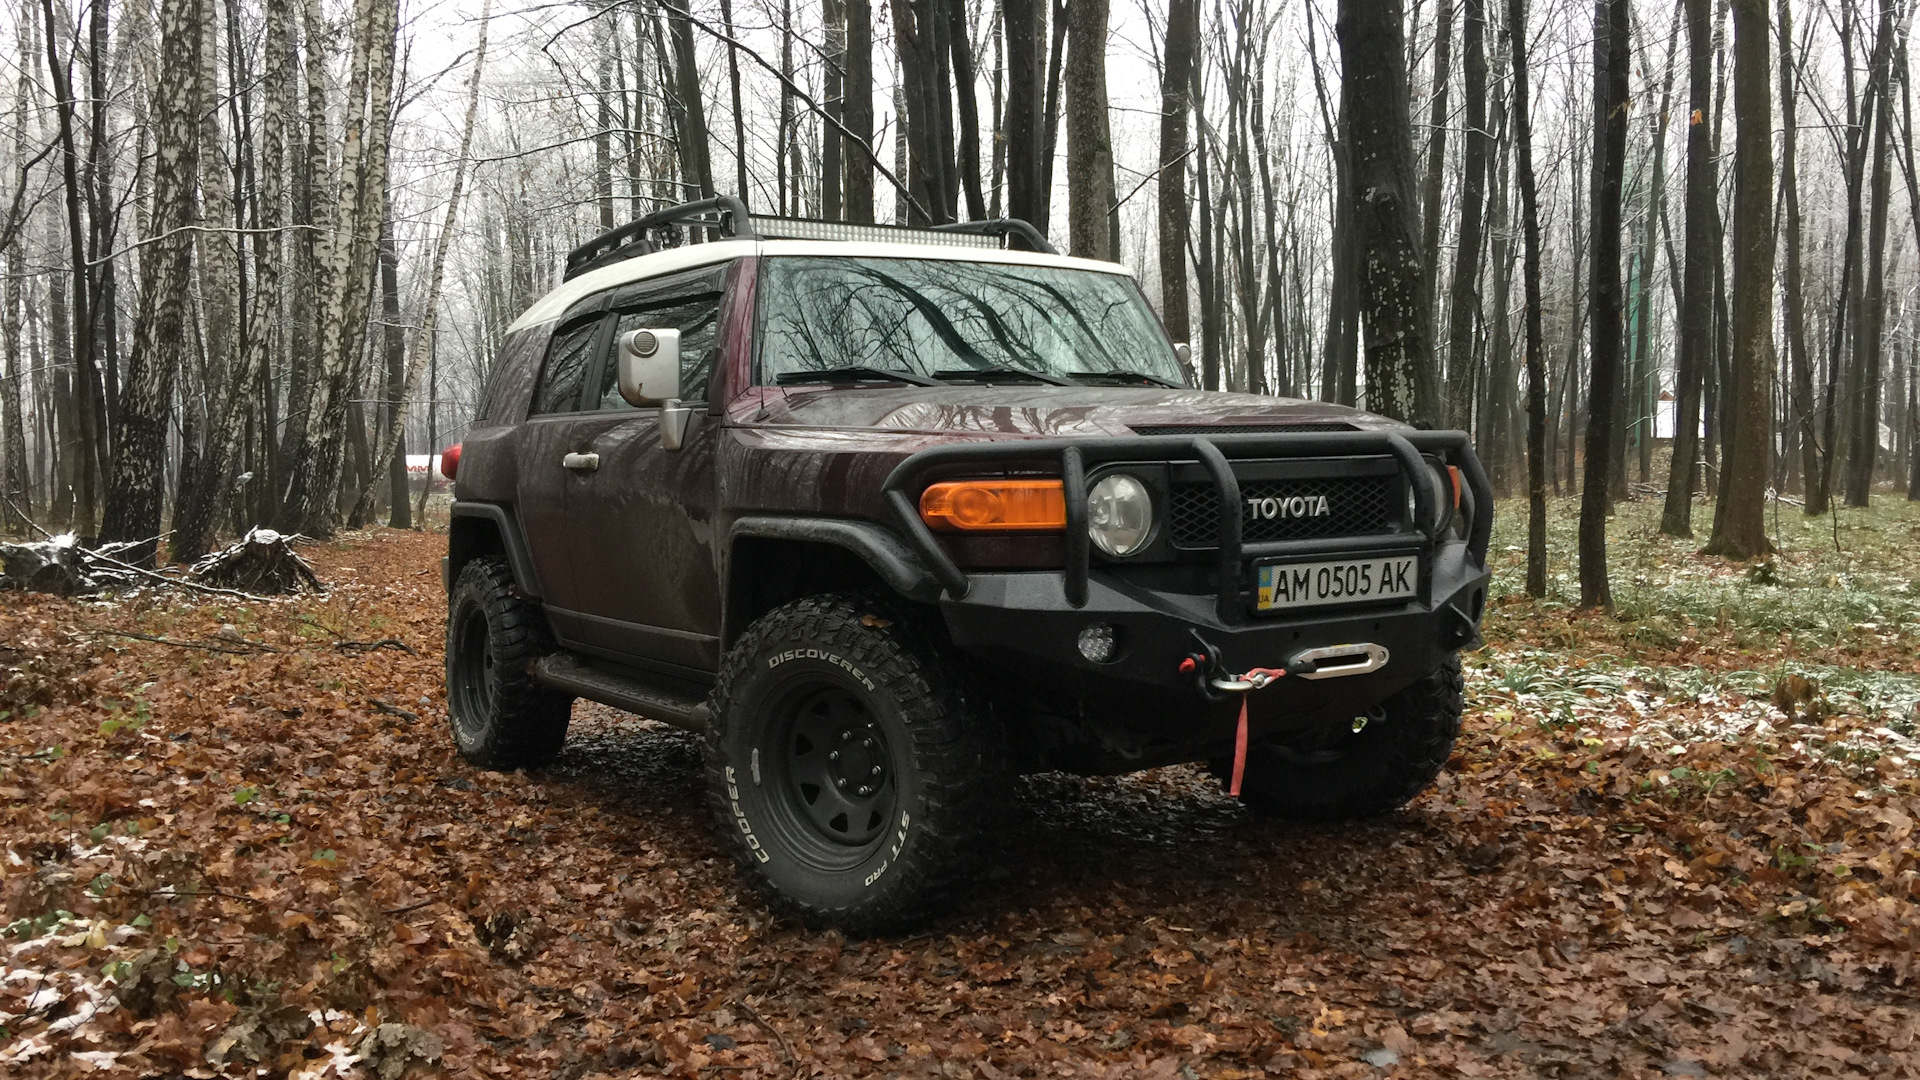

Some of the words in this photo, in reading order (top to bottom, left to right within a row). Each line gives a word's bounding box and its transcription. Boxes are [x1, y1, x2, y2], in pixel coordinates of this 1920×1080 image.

[1248, 496, 1331, 520] TOYOTA
[1258, 594, 1270, 604] UA
[1273, 568, 1311, 603] AM
[1317, 563, 1372, 599] 0505
[1378, 560, 1412, 594] AK
[768, 648, 875, 692] DISCOVERER
[725, 765, 770, 864] COOPER
[892, 810, 911, 862] STT
[864, 860, 888, 887] PRO
